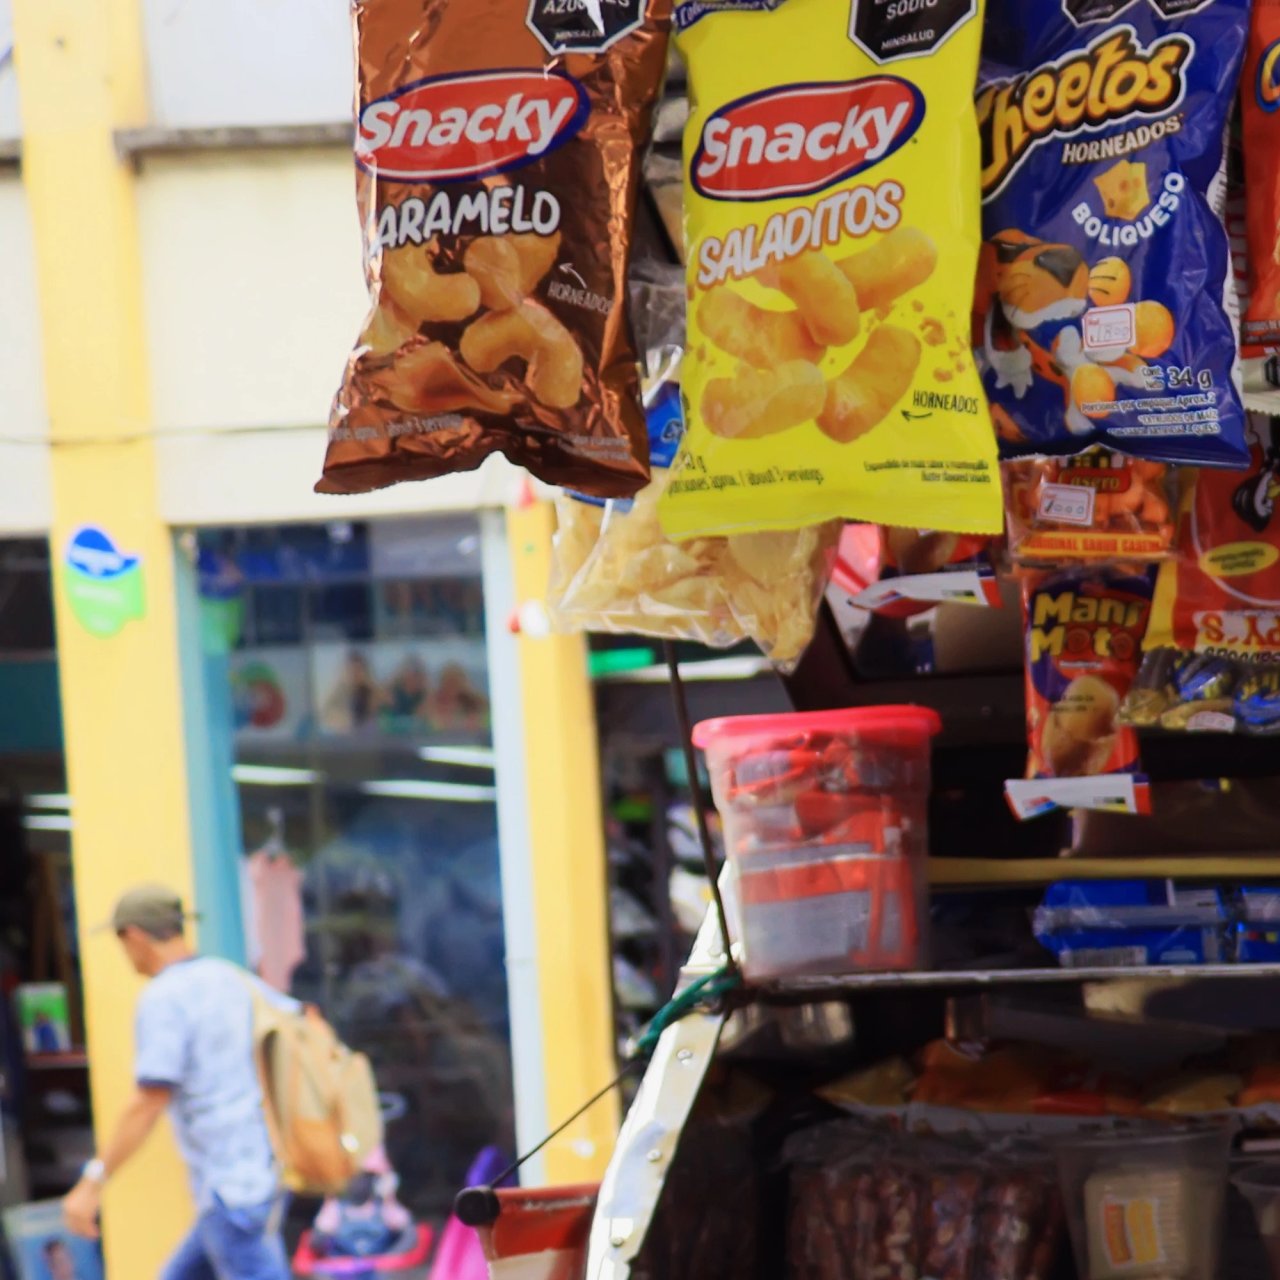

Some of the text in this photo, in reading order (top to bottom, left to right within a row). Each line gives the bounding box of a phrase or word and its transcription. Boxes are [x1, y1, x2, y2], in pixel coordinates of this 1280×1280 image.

[881, 29, 935, 50] MINSALUD
[357, 93, 574, 158] Snacky
[697, 99, 910, 178] Snacky
[1061, 116, 1182, 164] HORNEADOS
[370, 185, 561, 255] ARAMELO
[697, 181, 905, 287] SALADITOS
[913, 389, 979, 415] HORNEADOS
[1167, 366, 1213, 391] 34 g
